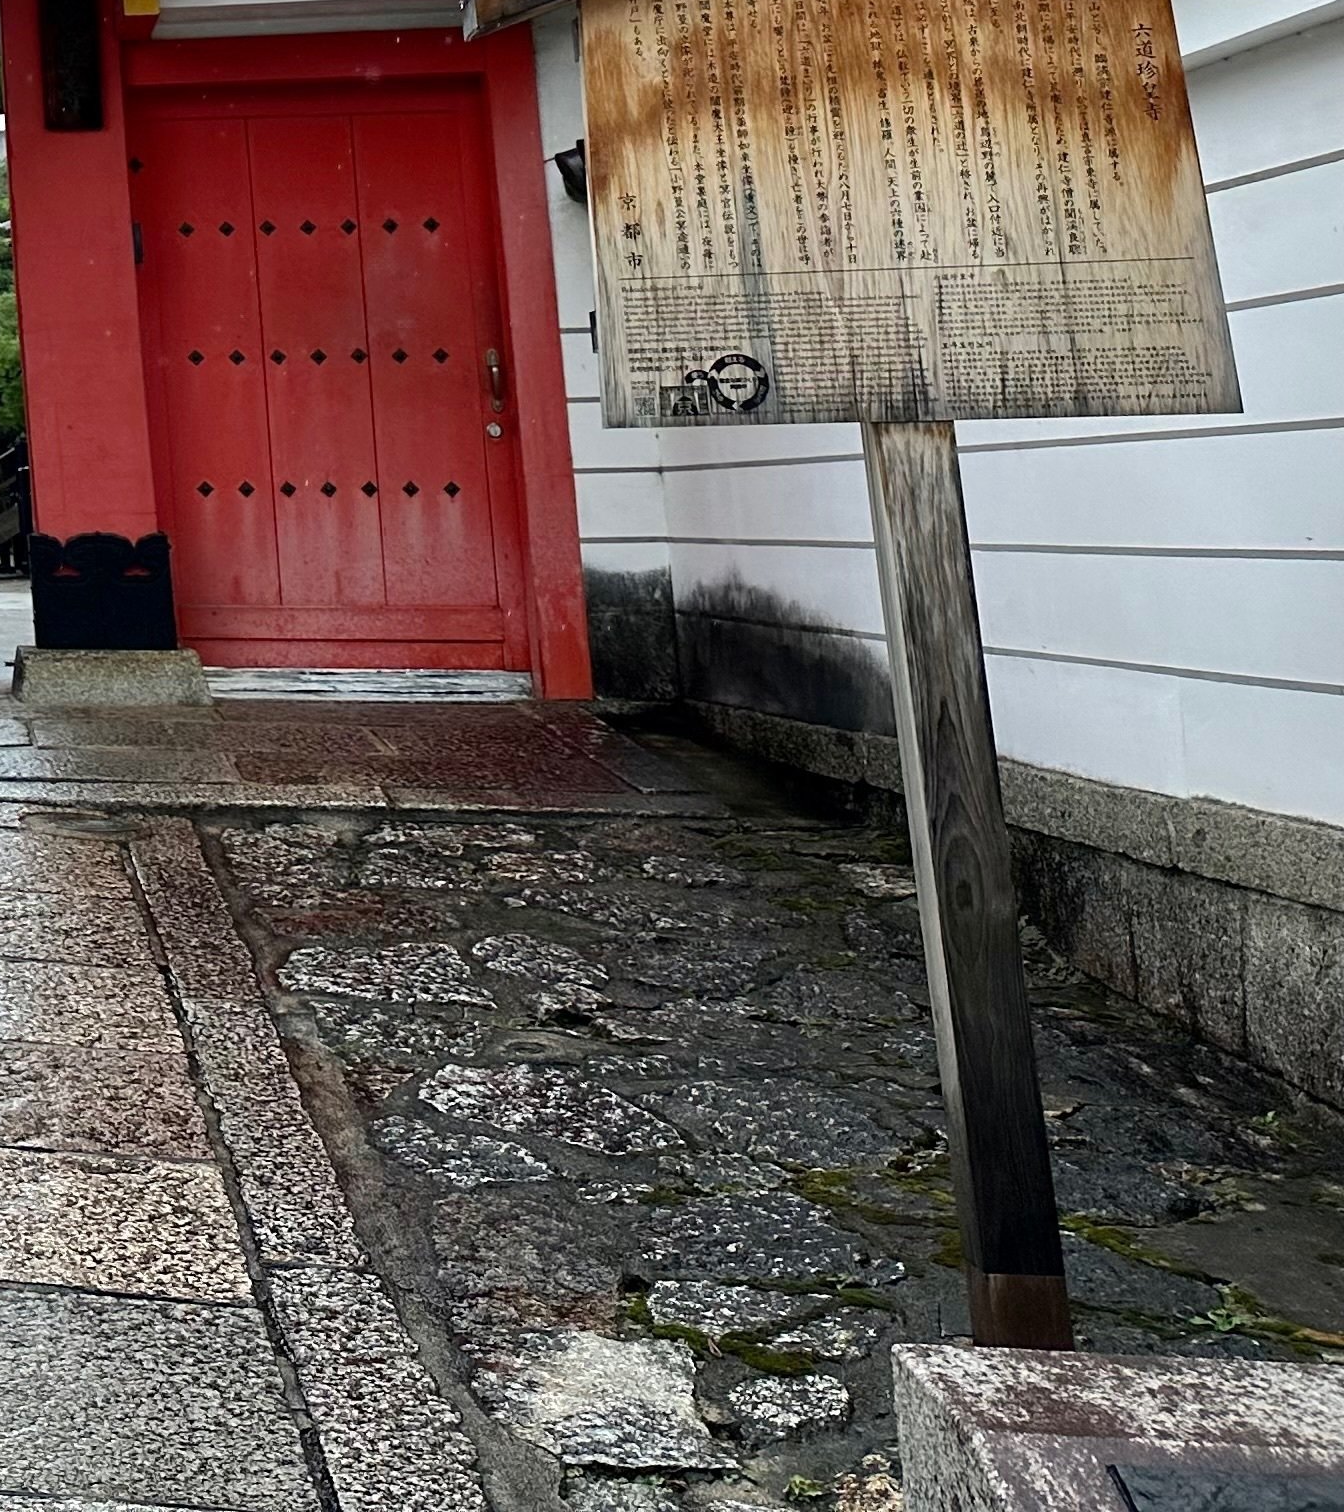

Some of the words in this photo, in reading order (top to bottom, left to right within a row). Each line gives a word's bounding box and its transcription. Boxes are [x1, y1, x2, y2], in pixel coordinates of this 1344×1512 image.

[1131, 23, 1163, 122] 六道珍皇寺
[617, 192, 644, 271] 京都市
